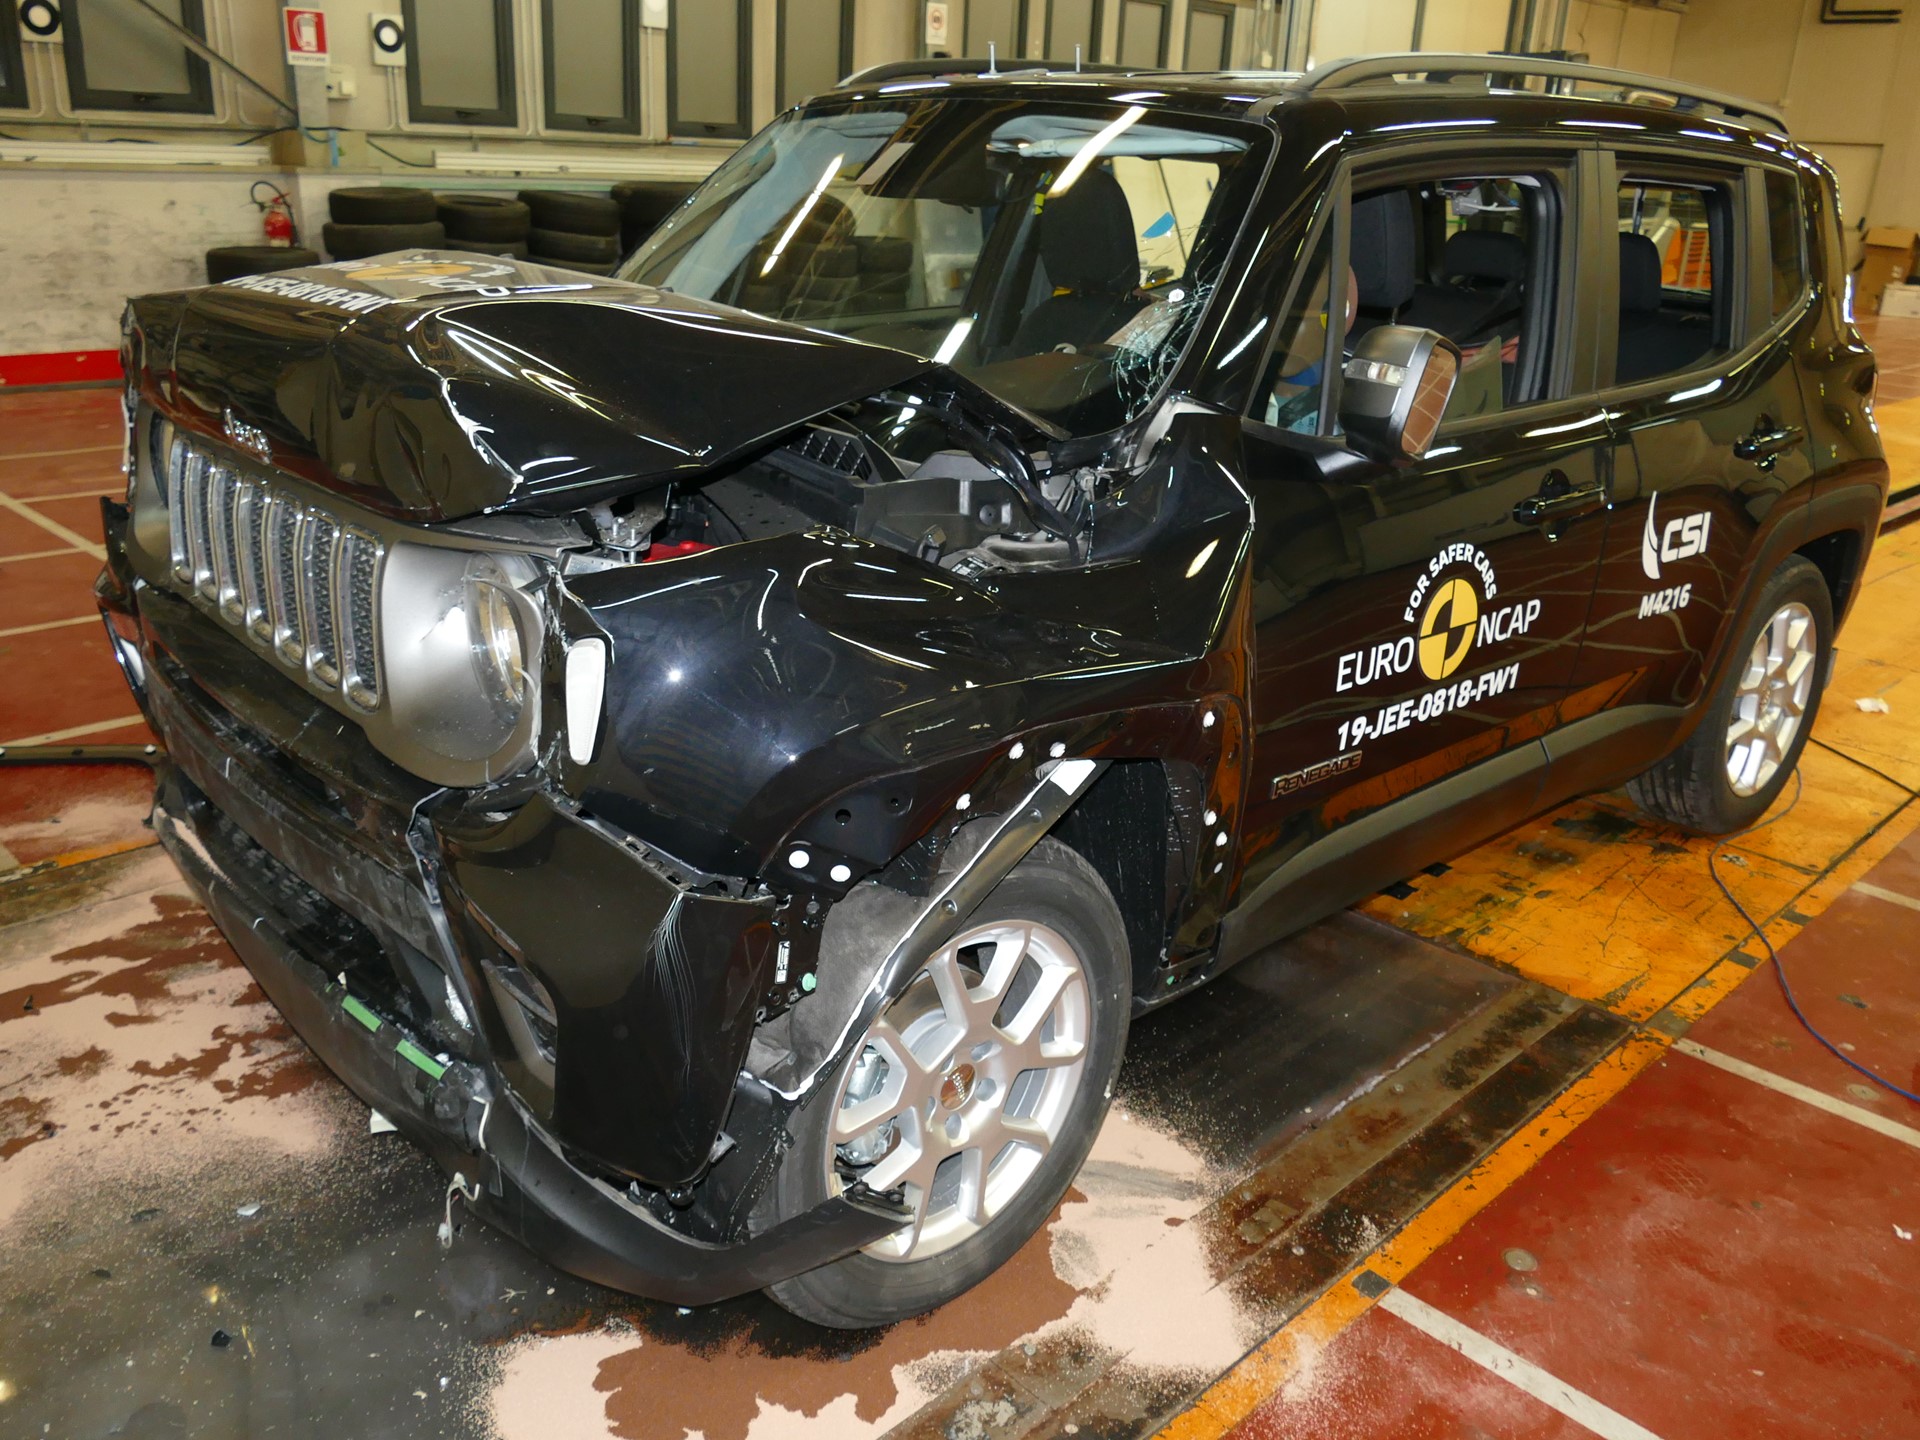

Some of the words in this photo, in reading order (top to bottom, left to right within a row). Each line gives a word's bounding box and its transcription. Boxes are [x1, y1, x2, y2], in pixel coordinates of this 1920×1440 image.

[1660, 511, 1711, 564] CSI
[1403, 574, 1431, 623] FOR
[1428, 542, 1475, 578] SAFER
[1473, 550, 1498, 600] CARS
[1638, 583, 1693, 620] M4216
[1335, 636, 1415, 693] EURO
[1476, 598, 1541, 648] NCAP
[1337, 661, 1520, 751] 19-JEE-0818-FW1
[1271, 749, 1363, 800] RENEGADE
